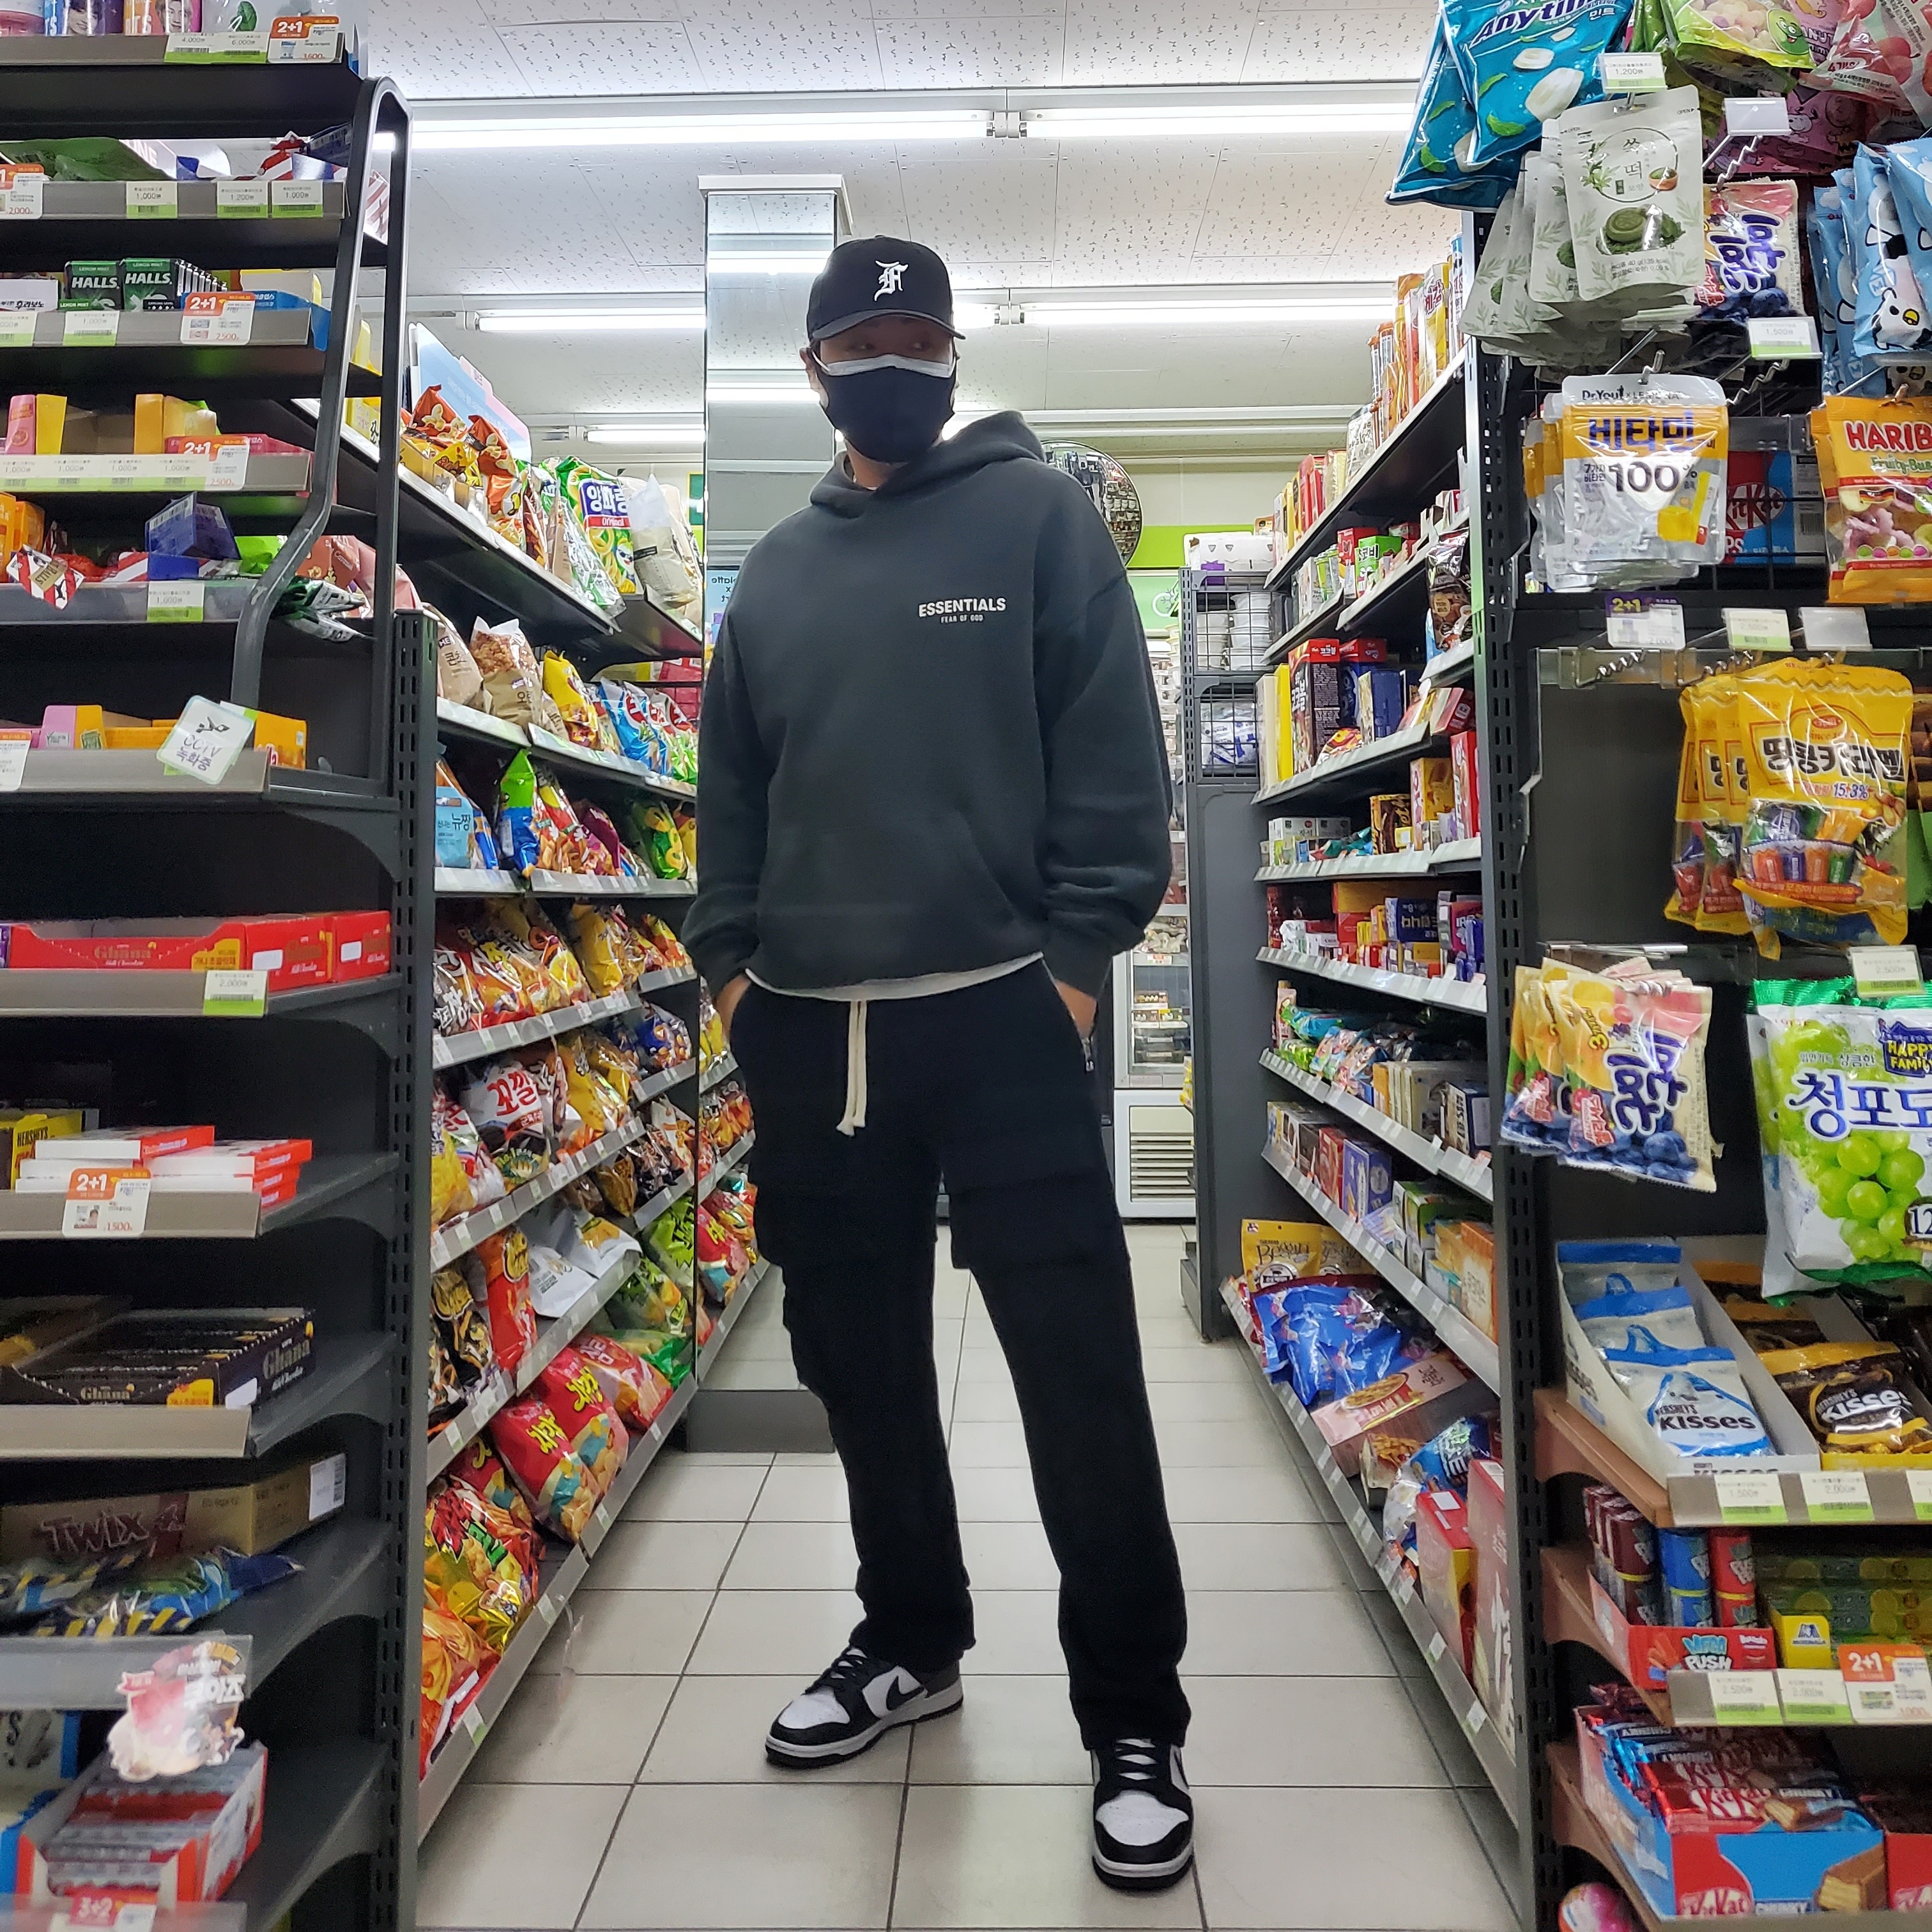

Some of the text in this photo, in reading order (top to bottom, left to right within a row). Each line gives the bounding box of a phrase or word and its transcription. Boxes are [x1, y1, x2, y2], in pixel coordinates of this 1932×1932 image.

[1589, 8, 1615, 20] 민트
[277, 21, 302, 33] 2+1
[1624, 160, 1643, 180] 떡
[72, 277, 118, 289] HALLS
[125, 272, 171, 285] HALLS
[190, 296, 217, 310] 2+1
[1588, 410, 1696, 452] 비타민
[185, 442, 211, 454] 2+1
[1608, 461, 1681, 493] 100
[601, 517, 625, 526] Original
[918, 597, 1007, 618] ESSENTIALS
[1613, 598, 1641, 612] 2+1
[940, 614, 984, 624] FEAR OF GOD
[183, 735, 223, 757] CCTV
[176, 746, 211, 771] 녹화중
[451, 813, 471, 831] 뉴짱
[17, 1126, 49, 1149] HERSHEY'S
[76, 1174, 107, 1192] 2+1
[263, 1340, 311, 1379] Ghana
[80, 1387, 130, 1400] Ghana
[42, 1504, 150, 1554] TWIX
[1848, 1652, 1883, 1672] 2+1
